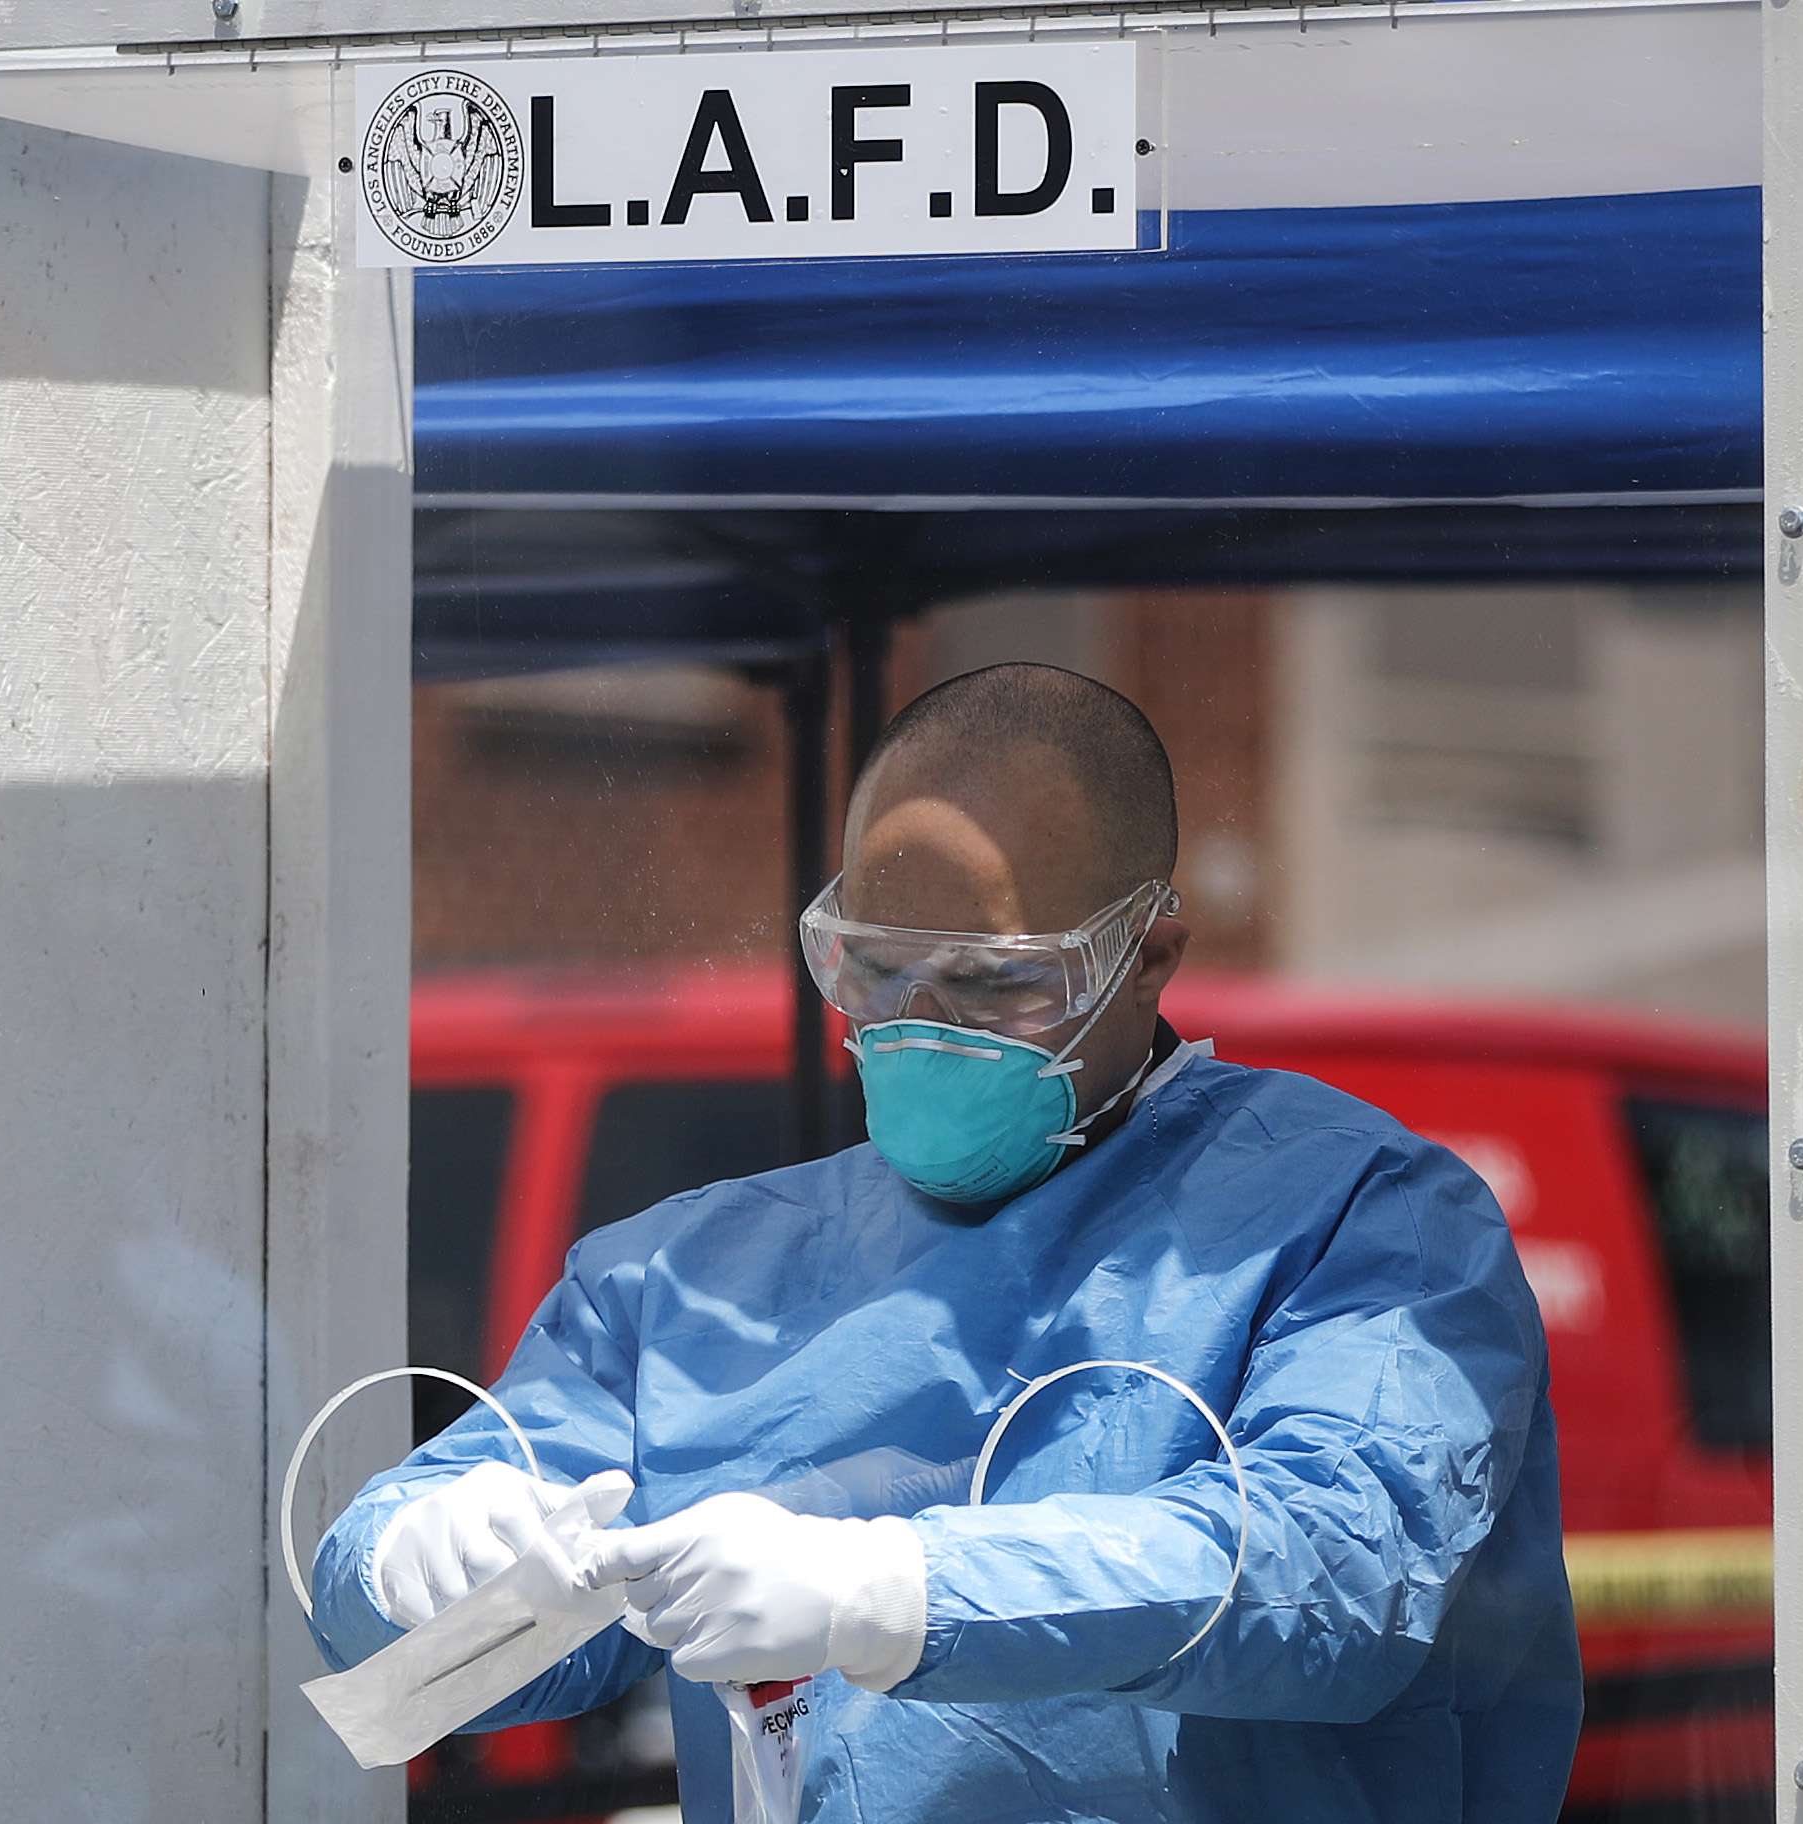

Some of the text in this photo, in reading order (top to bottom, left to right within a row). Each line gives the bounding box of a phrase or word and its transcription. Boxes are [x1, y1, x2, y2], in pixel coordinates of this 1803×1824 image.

[367, 76, 520, 213] LOS ANGELES CITY FIRE DEPARTMENT
[530, 80, 1115, 228] L.A.F.D.
[390, 221, 496, 257] FOUNDED 1886
